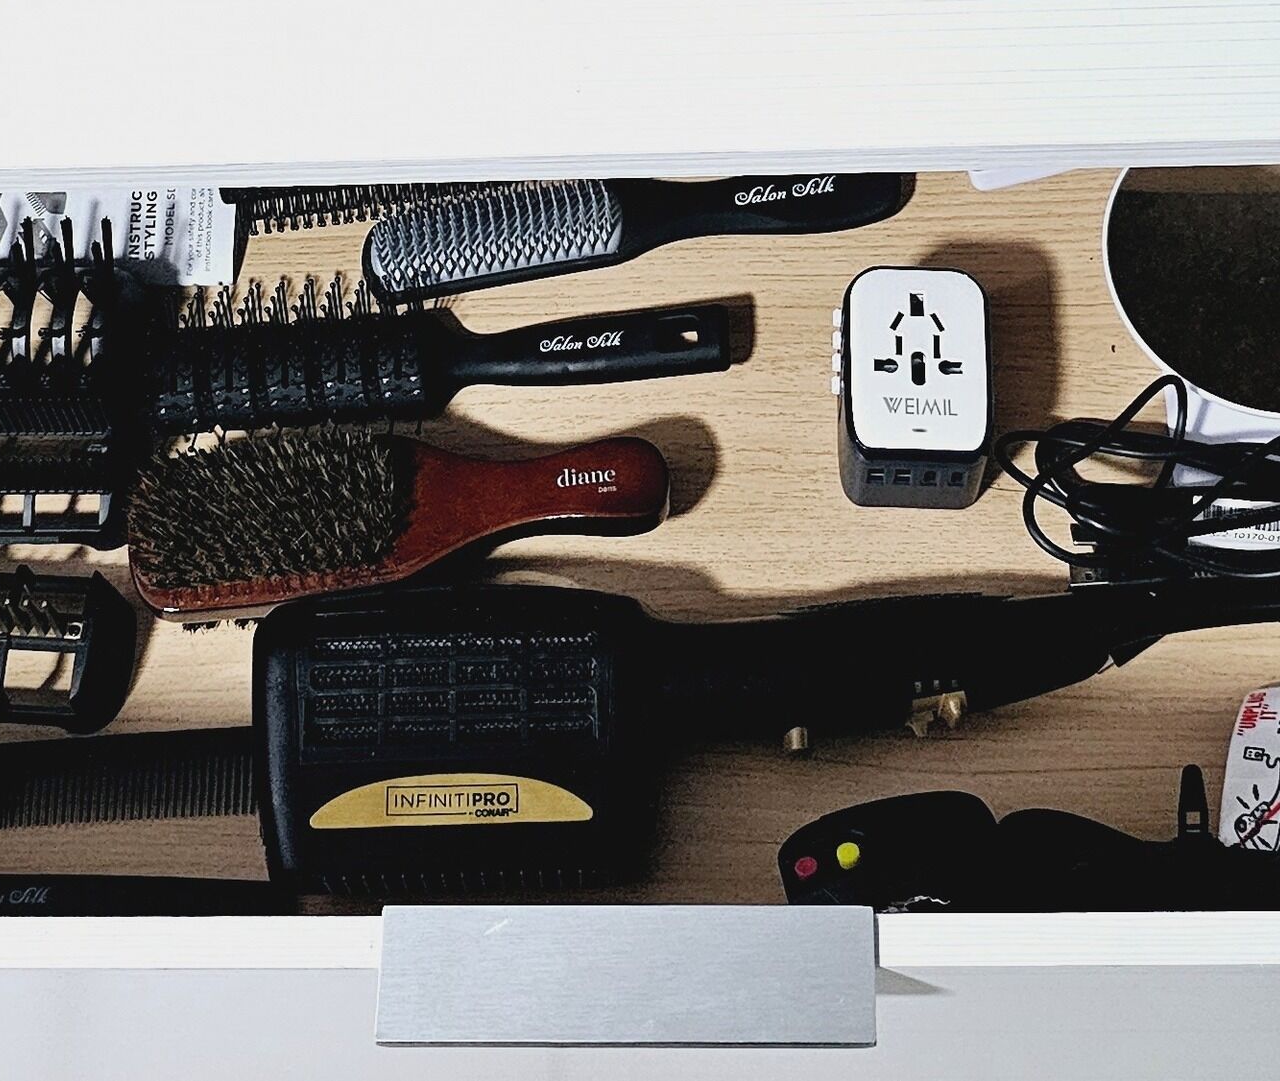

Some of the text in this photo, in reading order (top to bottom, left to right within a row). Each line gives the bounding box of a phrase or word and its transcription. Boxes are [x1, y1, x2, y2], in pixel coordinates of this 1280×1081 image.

[734, 175, 837, 206] Salon Silk
[144, 191, 158, 261] STYLING
[164, 203, 176, 246] MODEL
[539, 330, 625, 353] Salon Silk
[883, 397, 958, 416] WEIMIL
[556, 468, 617, 488] diane
[394, 791, 511, 809] INFINITIPRO
[9, 887, 50, 904] Silk
